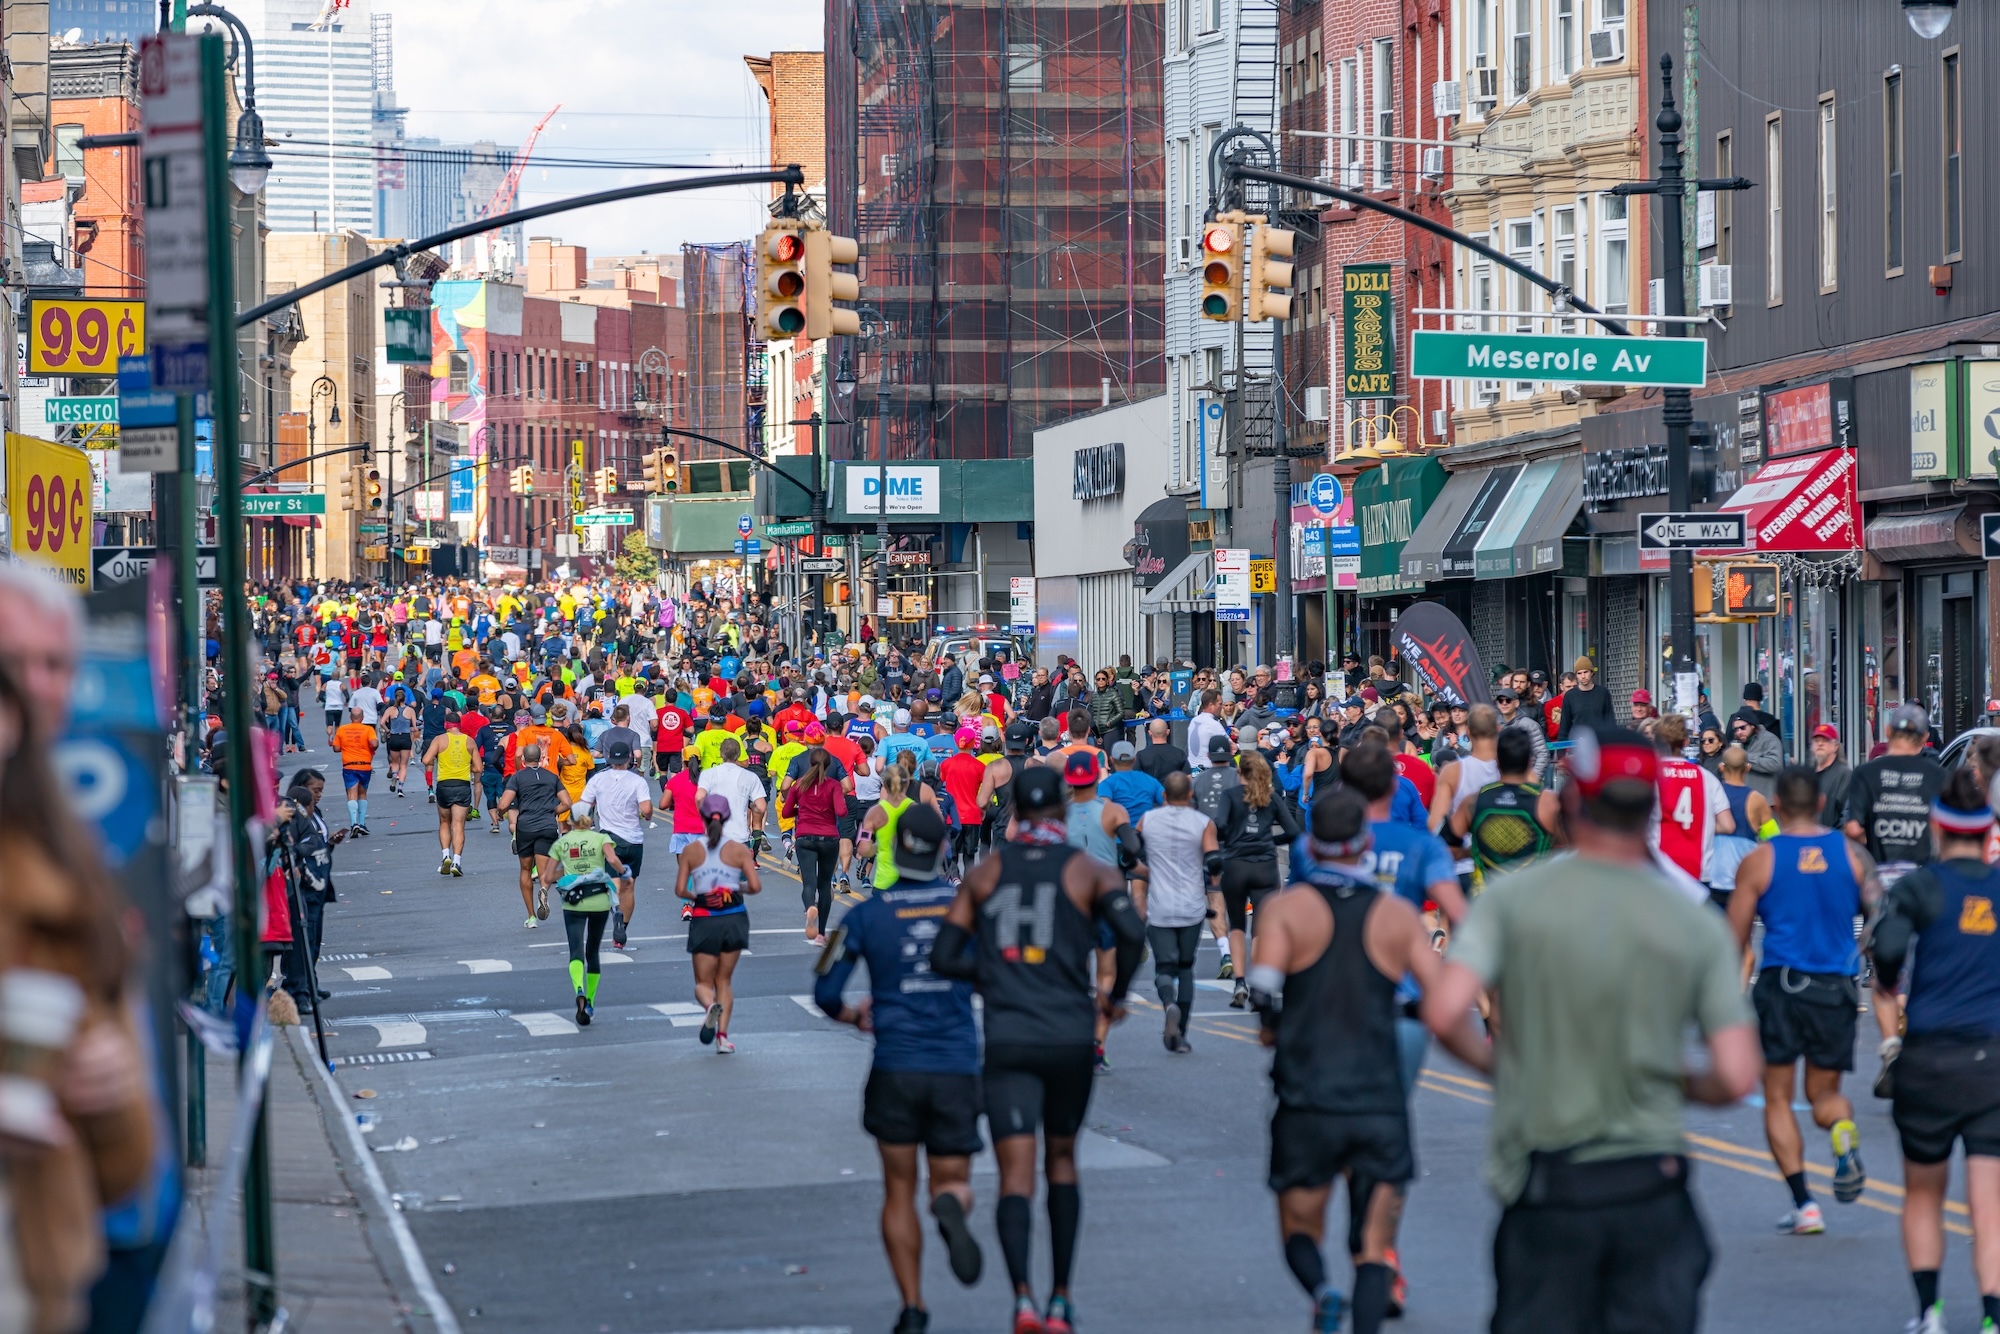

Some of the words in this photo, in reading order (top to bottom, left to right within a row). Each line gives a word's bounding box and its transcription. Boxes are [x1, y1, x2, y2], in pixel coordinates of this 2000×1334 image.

[1345, 273, 1389, 291] DELI
[1354, 295, 1382, 370] BAGELS
[1467, 344, 1597, 371] Meserole
[1612, 349, 1651, 372] Av
[1347, 374, 1390, 392] CAFE
[1911, 409, 1936, 433] del
[1209, 423, 1223, 484] CHASE
[573, 443, 583, 541] LIQUOS
[1759, 495, 1810, 543] EYEBROWS
[1803, 451, 1856, 501] THREADING
[27, 474, 84, 552] 99¢
[287, 499, 302, 510] St
[1801, 493, 1840, 529] WAXING
[767, 525, 804, 535] Manhattan
[1362, 501, 1390, 546] BAKER'S
[1389, 498, 1412, 542] DOZEN
[1656, 525, 1686, 538] ONE
[1700, 524, 1732, 537] WAY
[827, 537, 845, 546] Caly
[1306, 531, 1319, 541] B43
[891, 553, 916, 563] Calyer
[919, 553, 928, 562] St
[1306, 545, 1321, 554] B62
[113, 561, 149, 578] ONE
[1250, 563, 1273, 572] COPIES
[1401, 632, 1422, 659] WE
[1419, 657, 1446, 688] ARE
[1402, 649, 1438, 692] RUNNING
[1178, 681, 1186, 693] P
[876, 704, 892, 712] ABU
[1672, 786, 1694, 830] 4
[1874, 818, 1927, 839] CCNY
